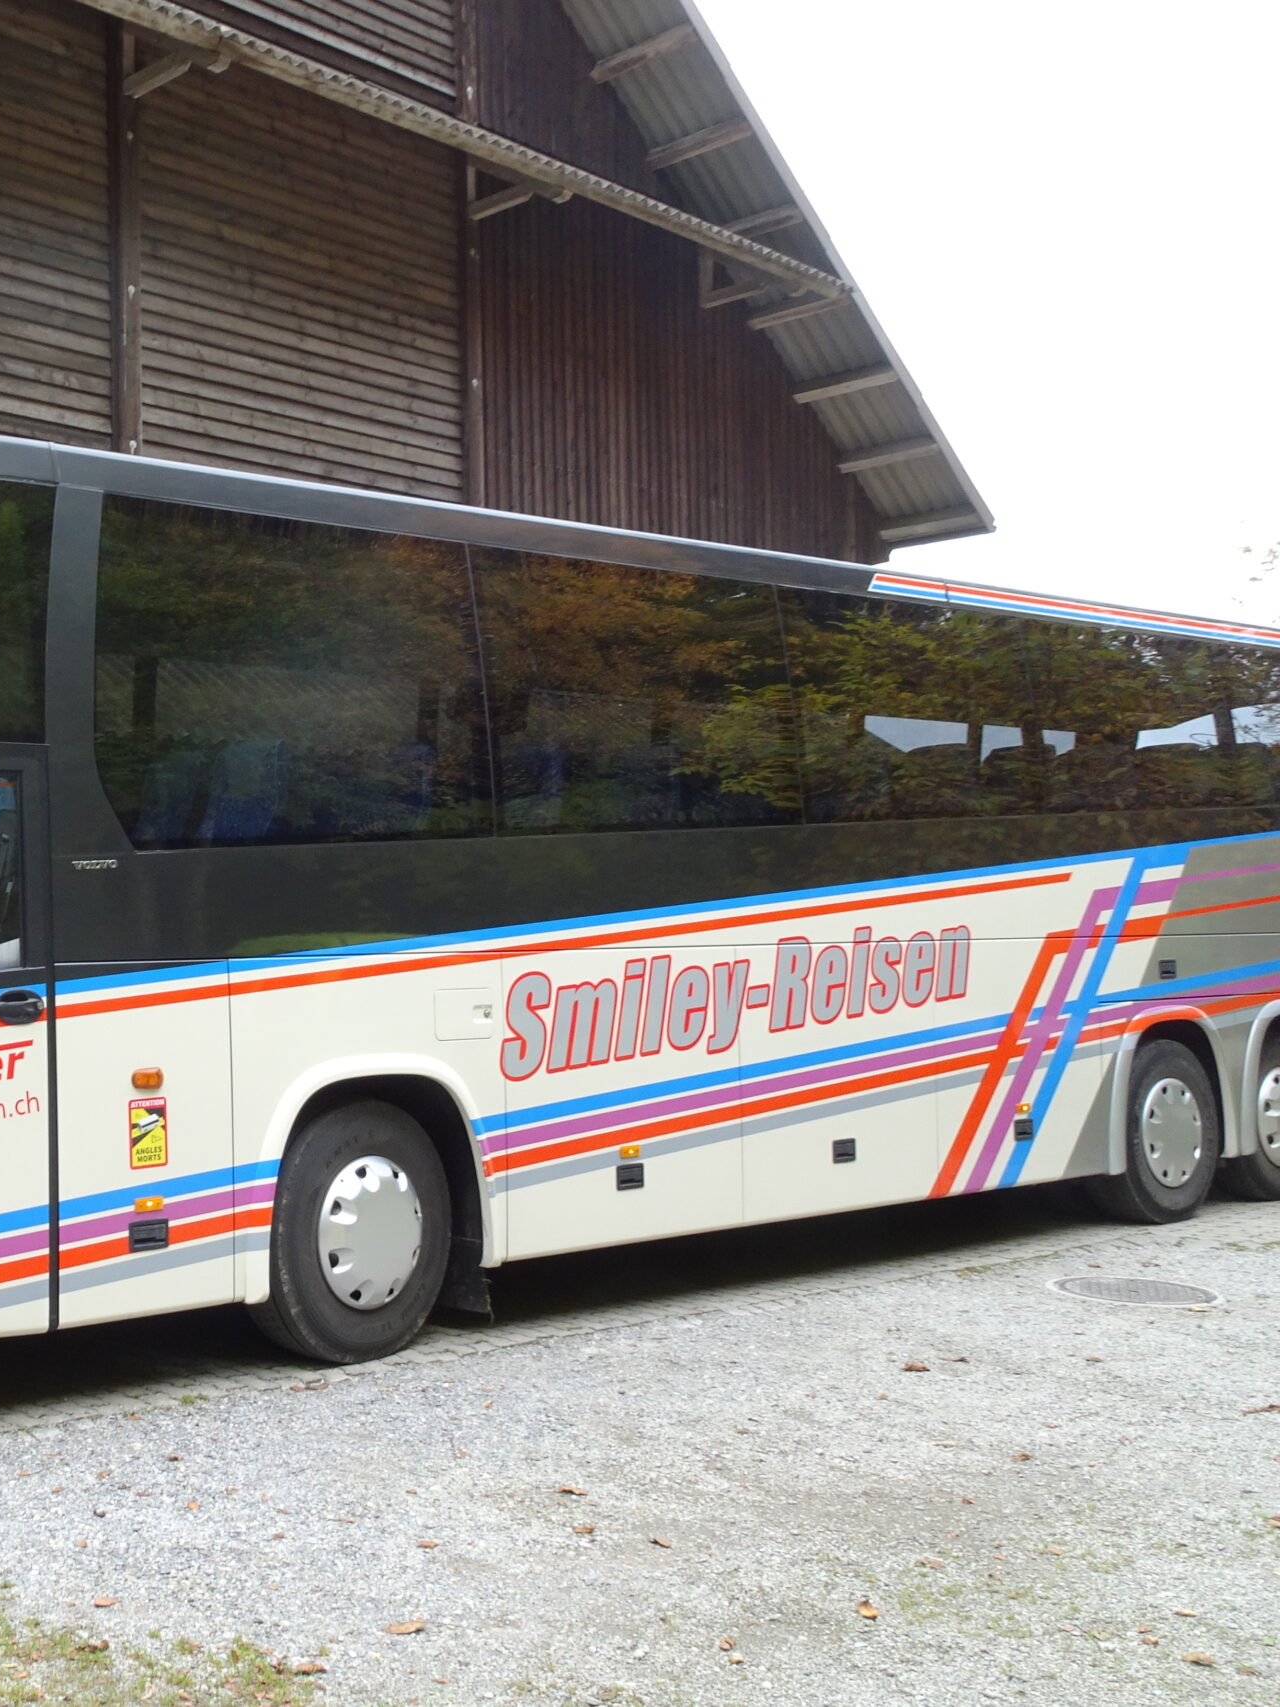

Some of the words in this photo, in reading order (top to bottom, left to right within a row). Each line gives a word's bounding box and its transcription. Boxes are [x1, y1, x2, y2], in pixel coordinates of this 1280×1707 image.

[72, 859, 118, 870] VOLVO
[499, 925, 970, 1081] Smiley-Reisen
[136, 1145, 162, 1155] ANGLES
[137, 1153, 161, 1163] MORTS
